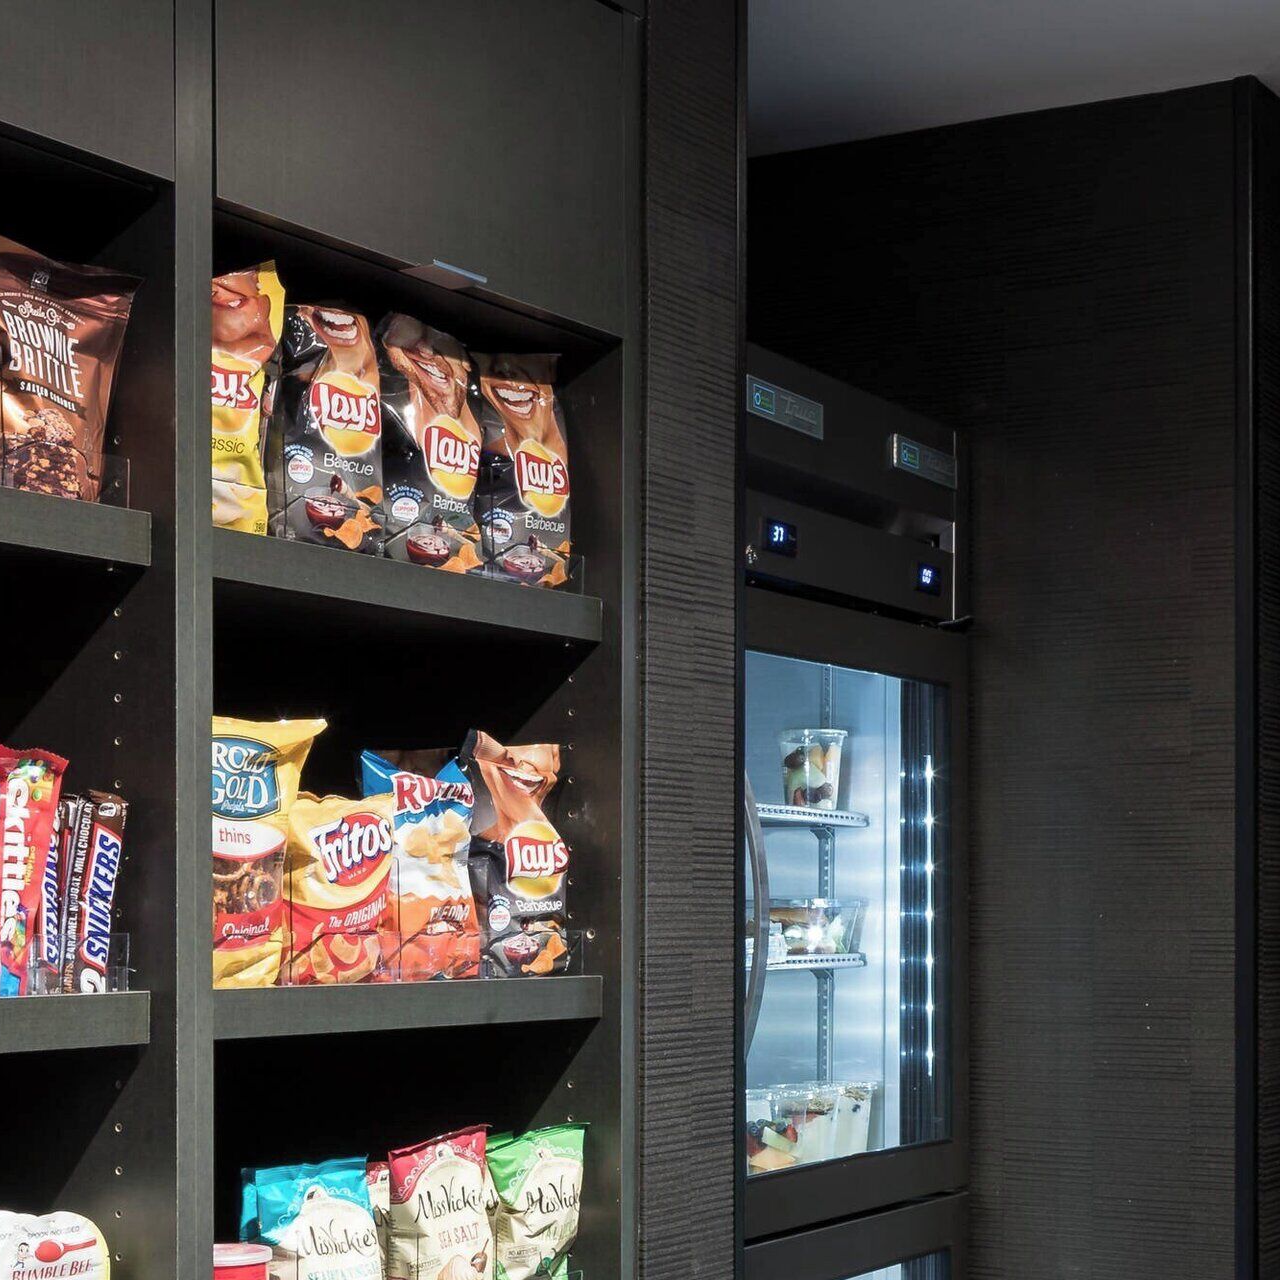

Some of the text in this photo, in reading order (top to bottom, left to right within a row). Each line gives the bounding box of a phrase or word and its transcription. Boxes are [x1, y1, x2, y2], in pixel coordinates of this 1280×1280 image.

[2, 310, 79, 368] BROWNIE
[8, 341, 84, 399] BRITTLE
[19, 380, 49, 398] SALTED
[317, 385, 379, 432] Lay's
[430, 427, 480, 475] Lay's
[521, 452, 568, 495] Lay's
[524, 514, 566, 534] Barbecue
[218, 827, 252, 845] thins
[309, 817, 393, 885] Fritos
[0, 777, 30, 942] Skittles
[512, 838, 568, 877] Lay's
[328, 914, 343, 928] The
[343, 899, 387, 927] ORIGINAL
[515, 899, 563, 914] Barbecue
[221, 916, 271, 942] Original
[438, 1222, 480, 1251] SEA SALT
